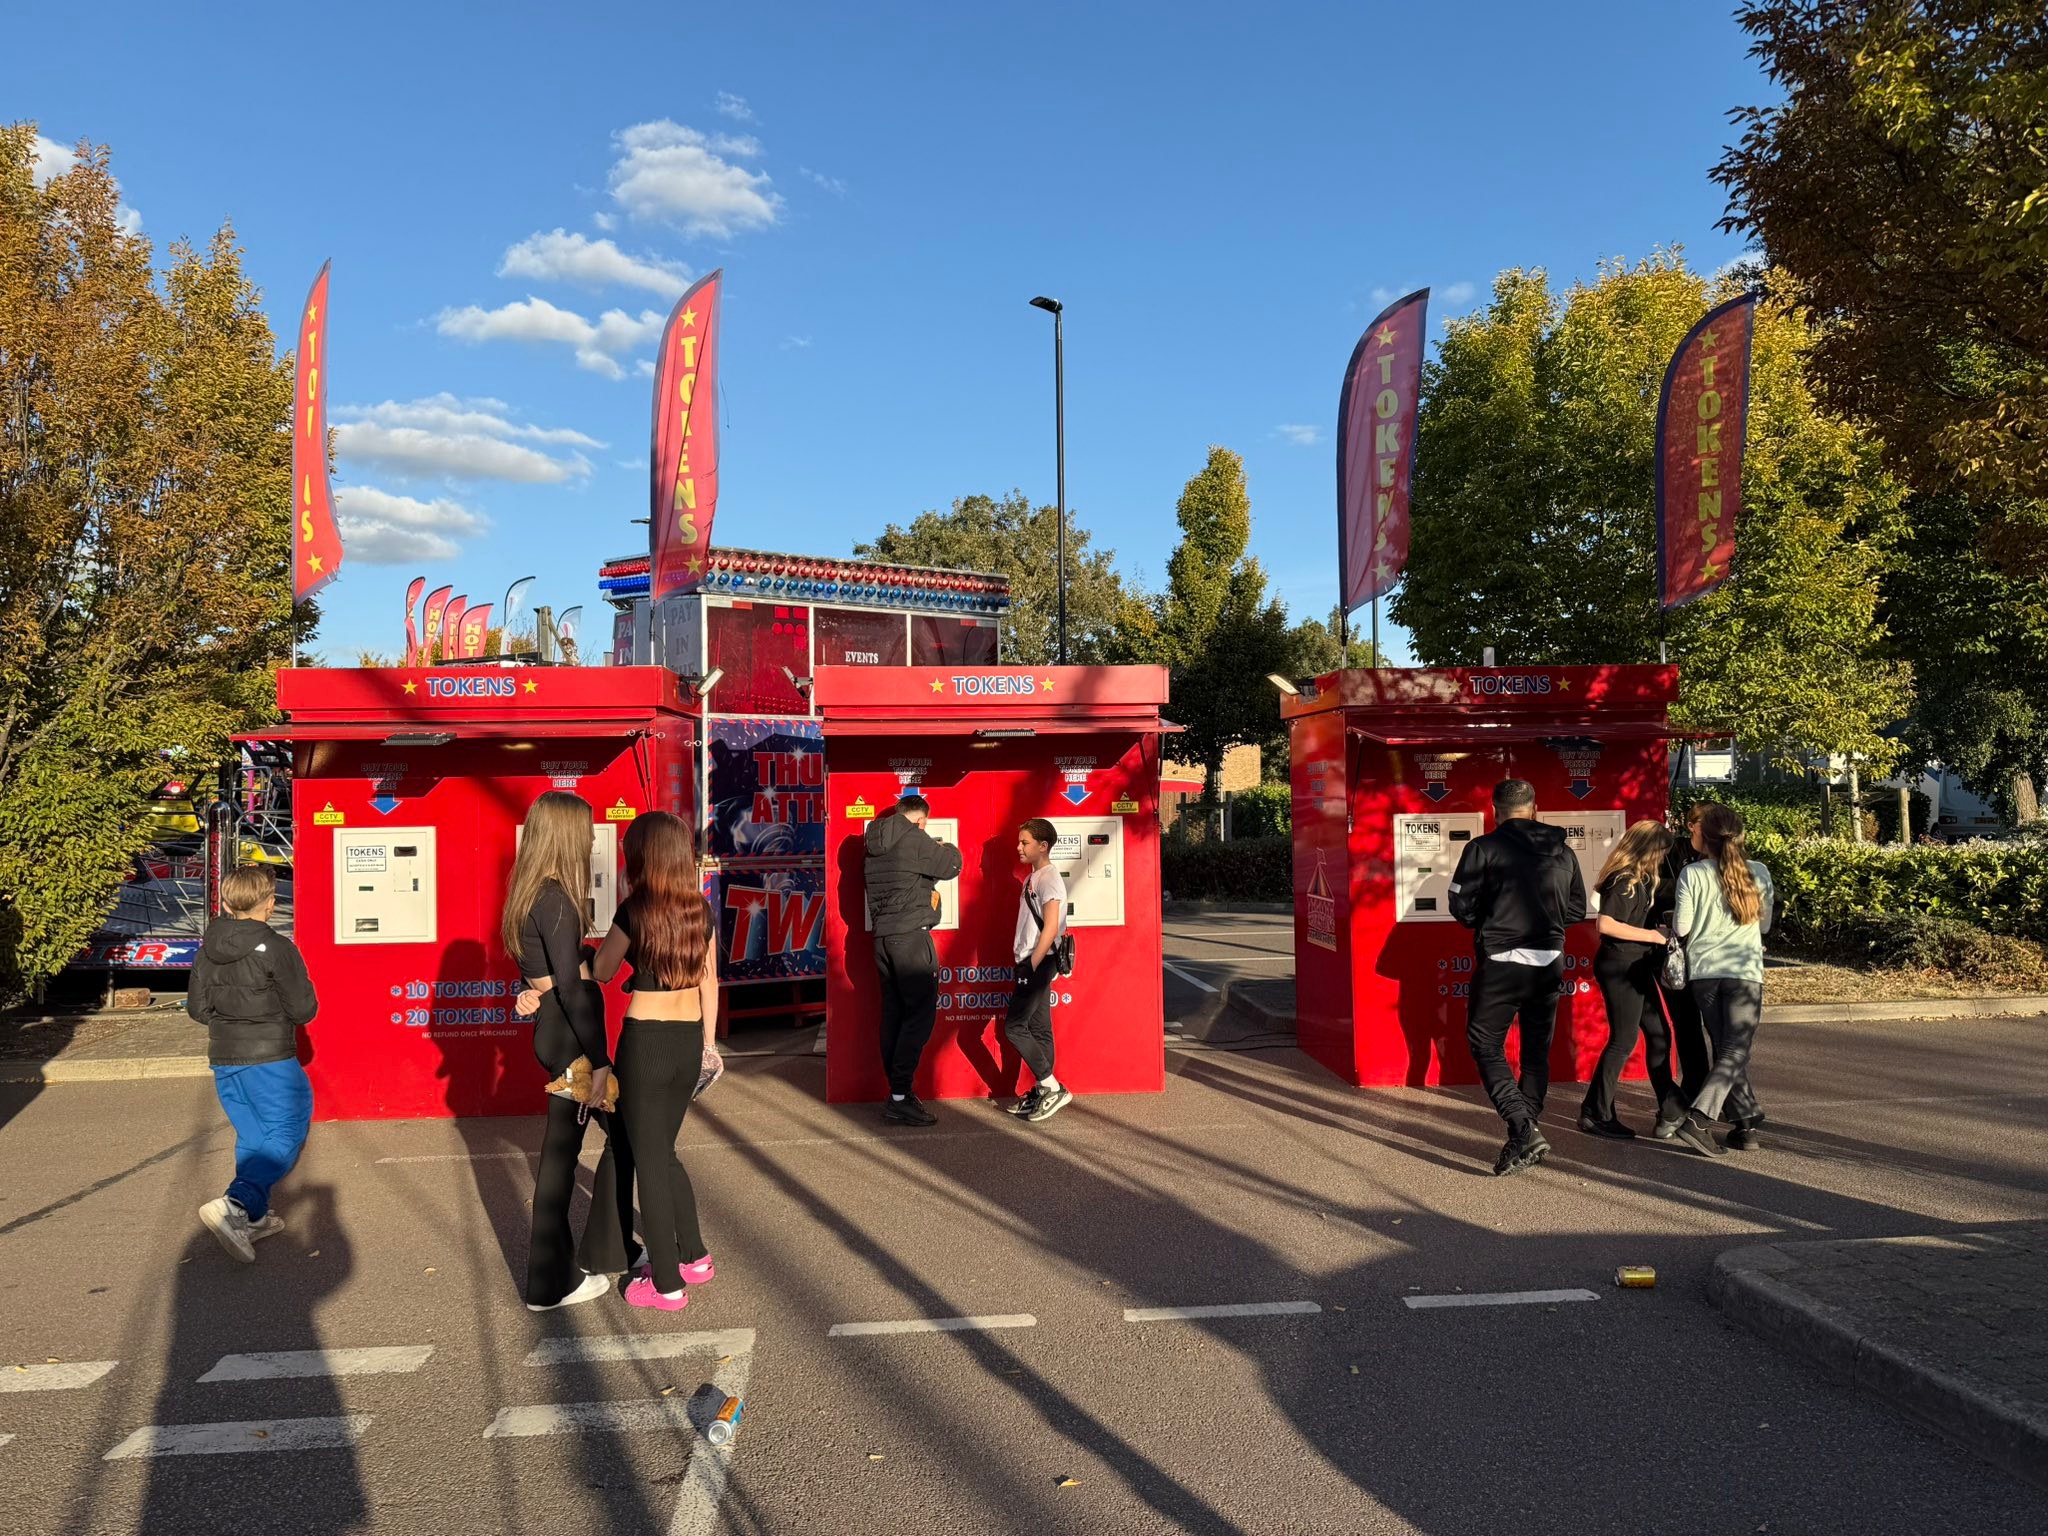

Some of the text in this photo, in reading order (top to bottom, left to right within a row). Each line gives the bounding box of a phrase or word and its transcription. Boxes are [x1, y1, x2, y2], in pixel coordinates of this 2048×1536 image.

[1696, 356, 1723, 553] TOKENS
[845, 651, 879, 664] EVENTS
[426, 677, 516, 697] TOKENS
[952, 676, 1034, 696] TOKENS
[1469, 676, 1551, 695] TOKENS
[541, 761, 588, 769] BUY YOUR
[546, 770, 583, 778] TOKENS
[1065, 773, 1087, 782] HERE
[1424, 771, 1447, 779] HERE
[553, 779, 577, 788] HERE
[1405, 823, 1439, 834] TOKENS
[349, 848, 384, 857] TOKENS
[726, 884, 827, 964] TW
[1452, 956, 1472, 972] 10
[955, 966, 1015, 983] TOKEN
[406, 982, 428, 999] 10
[432, 980, 505, 998] TOKENS
[1452, 981, 1471, 997] 20
[955, 992, 1013, 1009] TOKEN
[406, 1009, 429, 1026] 20
[433, 1008, 506, 1025] TOKENS
[422, 1031, 431, 1039] NO
[479, 1029, 518, 1037] PURCHASED
